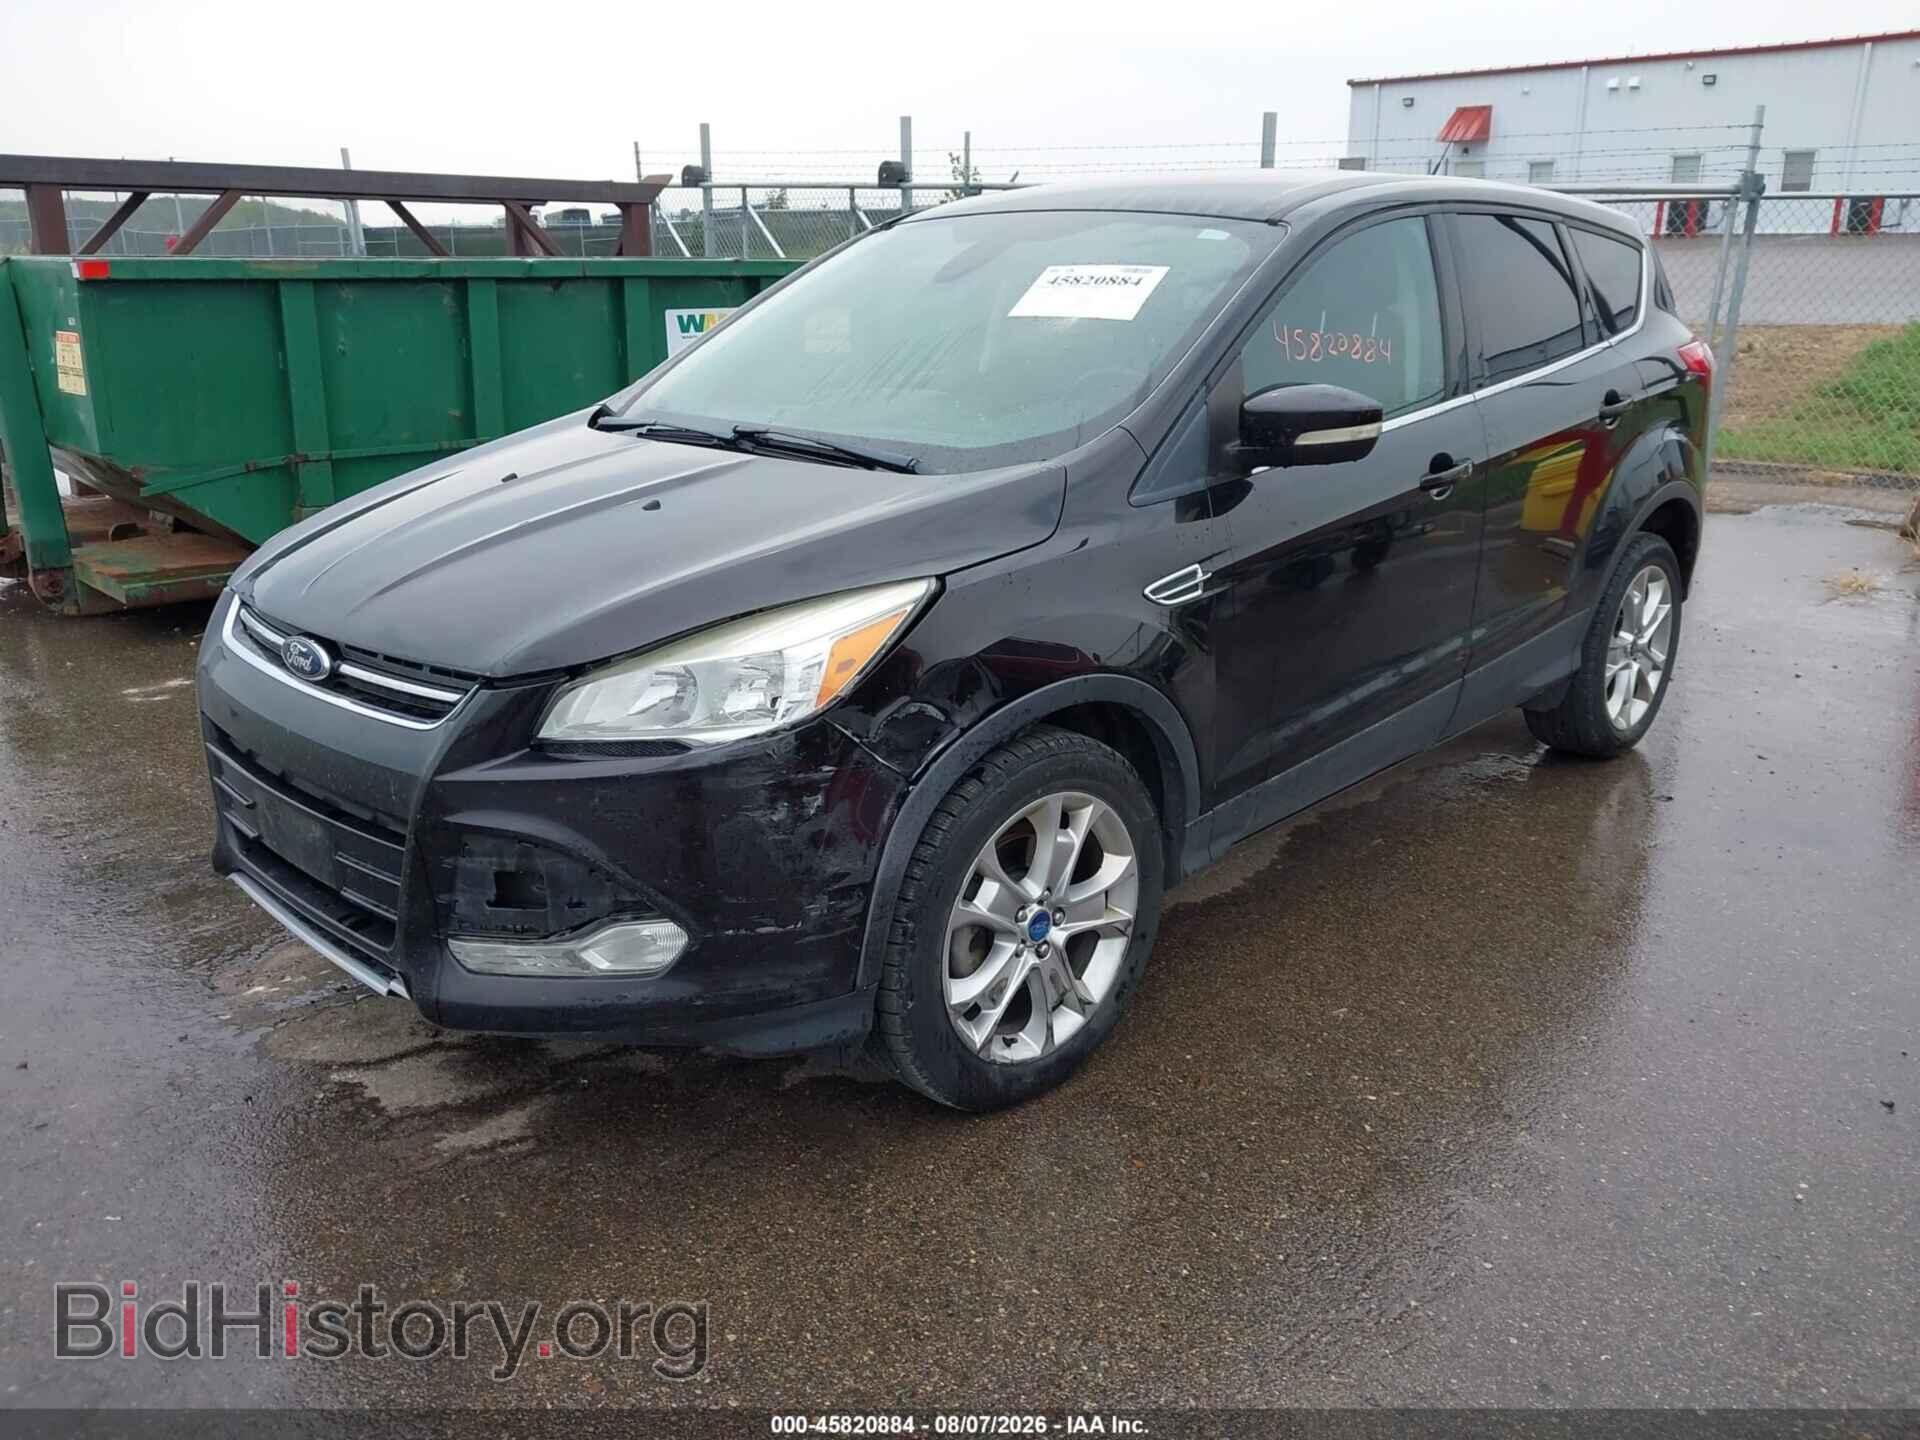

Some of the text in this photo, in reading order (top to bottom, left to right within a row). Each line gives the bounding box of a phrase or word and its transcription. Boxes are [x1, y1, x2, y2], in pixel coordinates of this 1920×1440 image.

[1047, 275, 1144, 286] 45820884
[1273, 318, 1391, 364] 45820884
[287, 642, 313, 671] Ford
